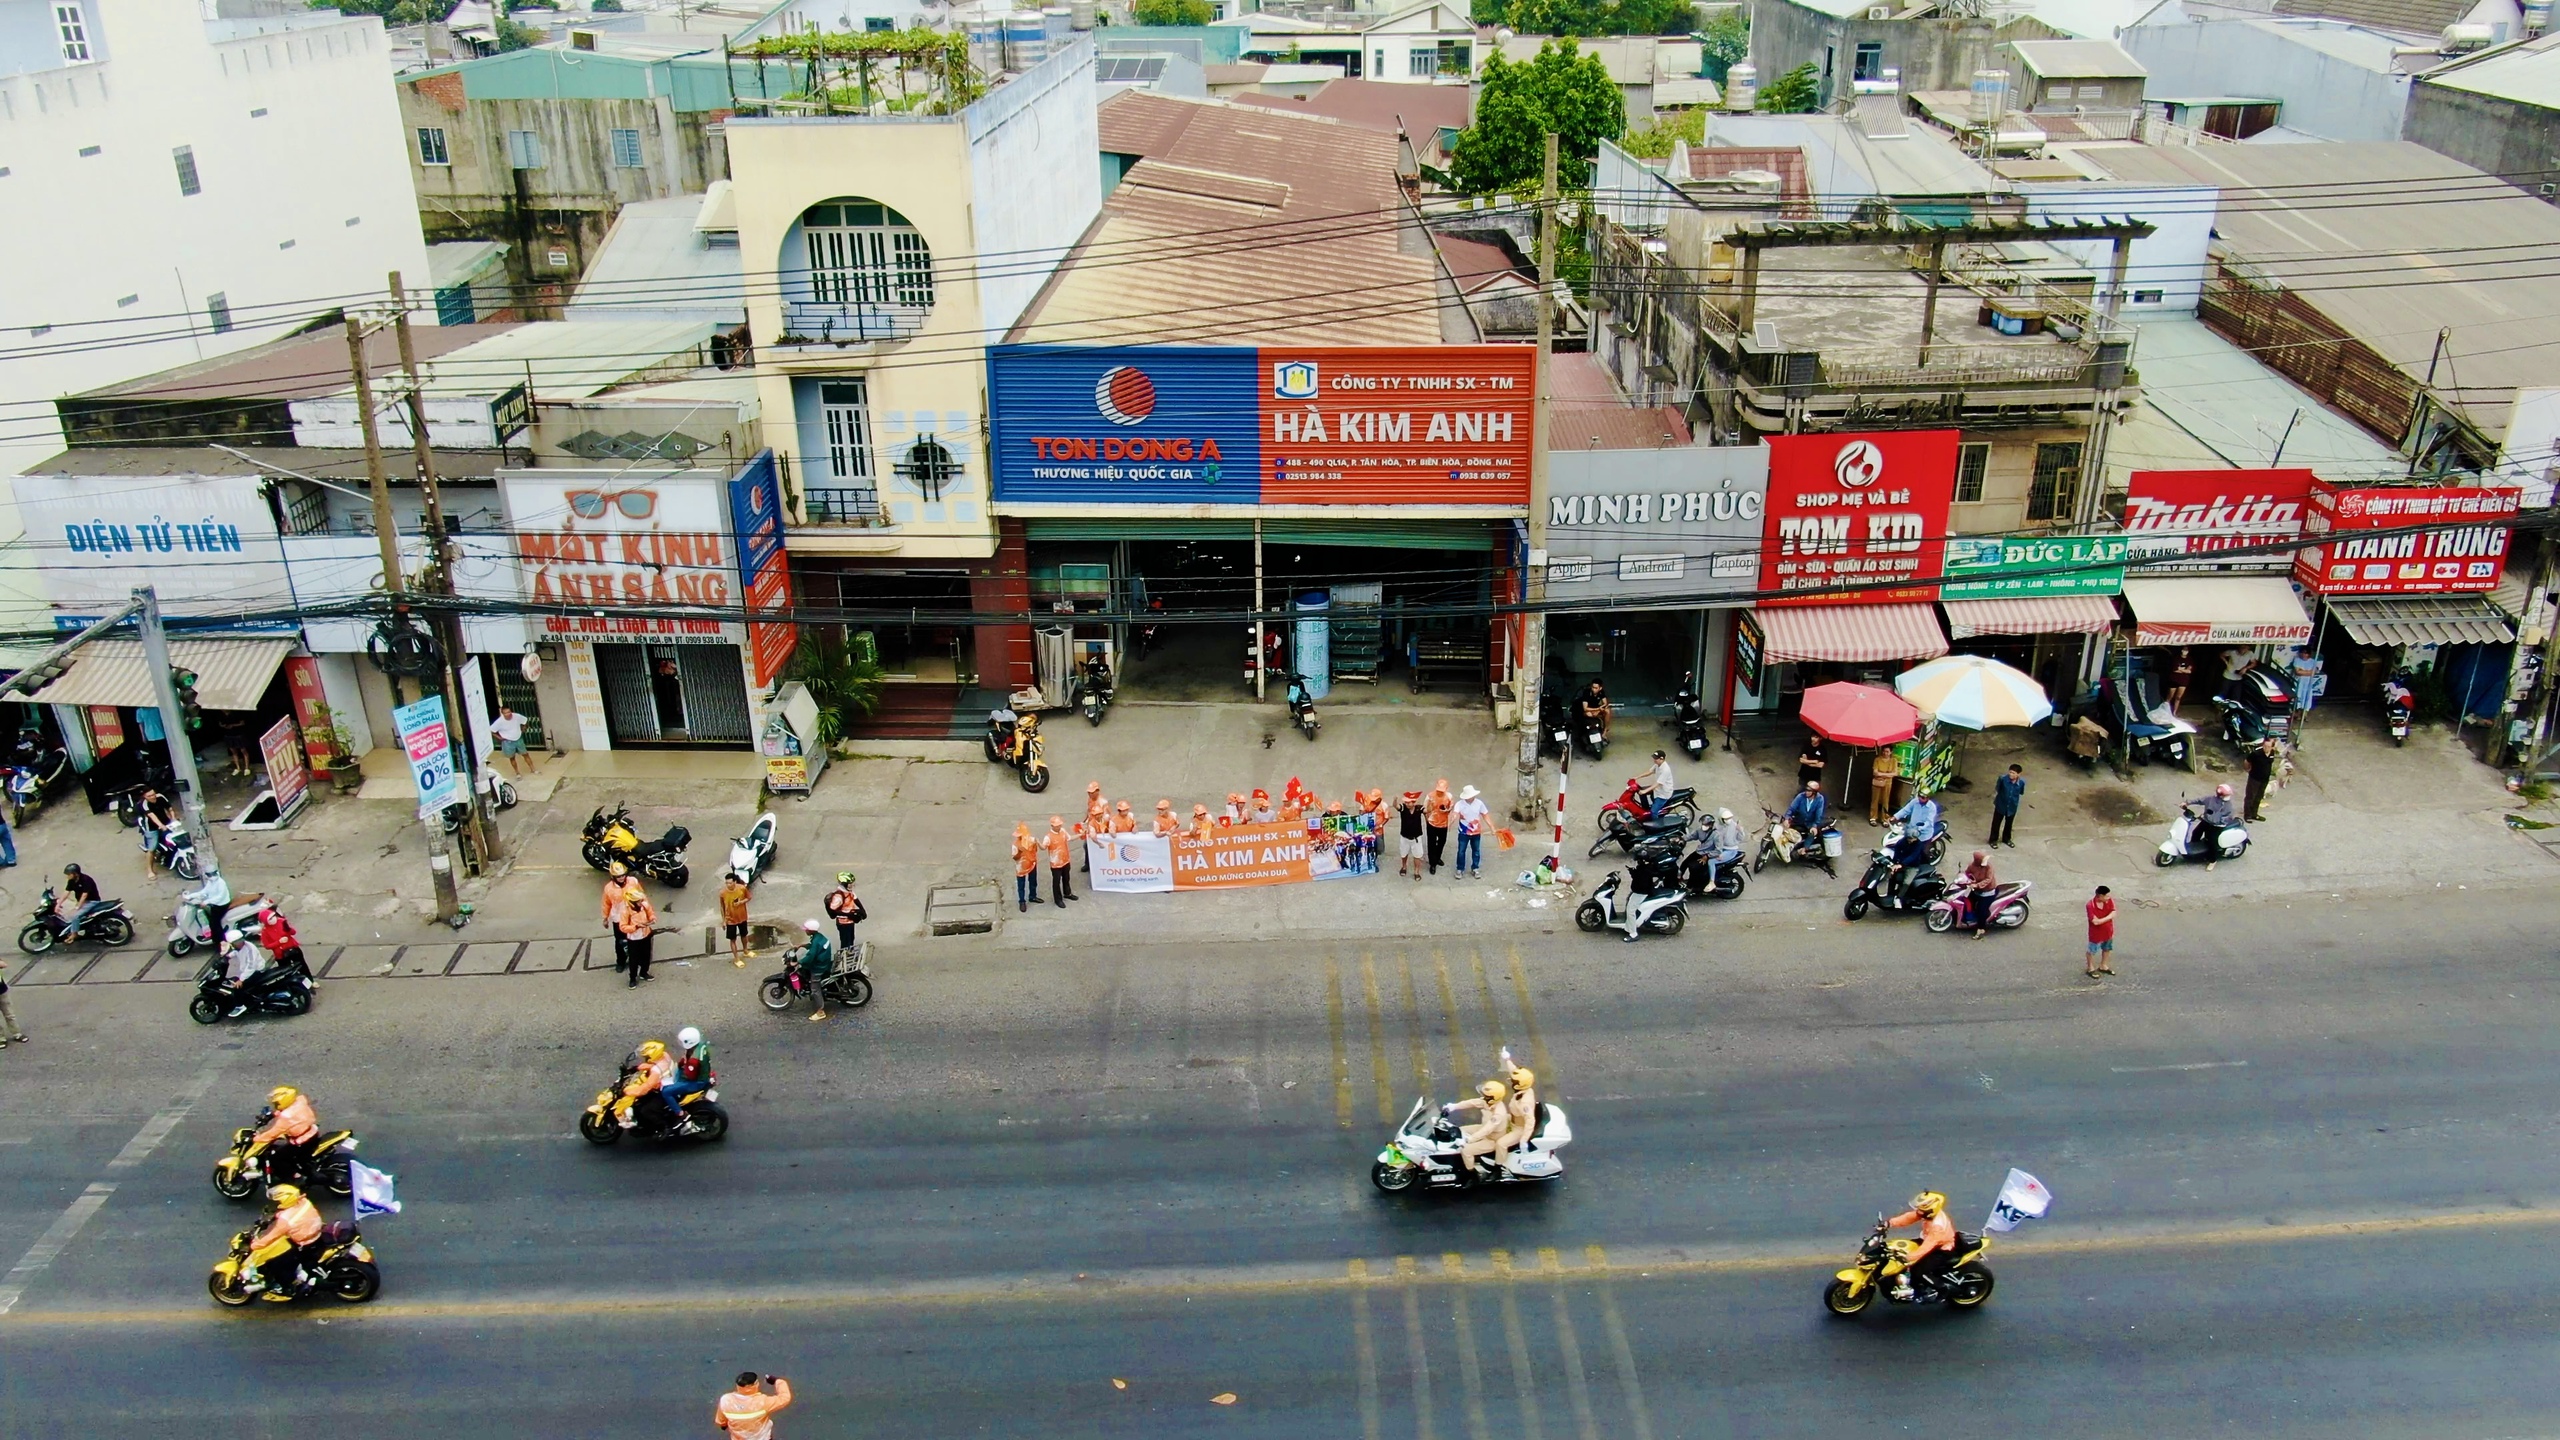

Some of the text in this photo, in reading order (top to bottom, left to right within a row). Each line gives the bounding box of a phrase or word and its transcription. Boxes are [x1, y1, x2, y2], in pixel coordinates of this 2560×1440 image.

[1331, 374, 1513, 389] CÔNG TY TNHH SX TM
[1274, 404, 1512, 442] HÀ KIM ANH
[1031, 437, 1222, 461] TON DONG A
[1360, 457, 1377, 466] TÂN
[1032, 465, 1193, 481] THƯƠNG HIỆU QUỐC GIA
[1550, 479, 1761, 526] MINH PHÚC
[1796, 493, 1838, 507] SHOP
[1841, 493, 1863, 508] MẸ
[1868, 489, 1886, 504] VÀ
[2366, 496, 2391, 515] CÔNG
[2391, 499, 2405, 514] TY
[65, 515, 242, 559] ĐIỆN TỬ TIẾN
[518, 515, 607, 565] MẮT
[620, 521, 721, 565] KÍNH
[1780, 514, 1923, 555] TOM KID
[2423, 527, 2507, 558] TRUNG
[2004, 539, 2125, 565] ĐỨC LẬP
[1554, 556, 1754, 577] Apple Android Laptop
[1862, 558, 1877, 572] ÁO
[1894, 558, 1919, 571] SINH
[532, 566, 617, 605] ÁNH
[2252, 623, 2311, 639] HOÀNG
[716, 637, 728, 645] 024
[404, 713, 440, 731] LONG CHÂU
[409, 734, 432, 751] KHÔNG
[433, 732, 444, 741] LO
[420, 762, 449, 790] 0%
[1179, 830, 1303, 849] CÔNG TY TNHH SX TM
[1177, 844, 1306, 871] HÀ KIM ANH
[1100, 866, 1164, 876] TON DONG A
[1195, 873, 1217, 883] CHÀO
